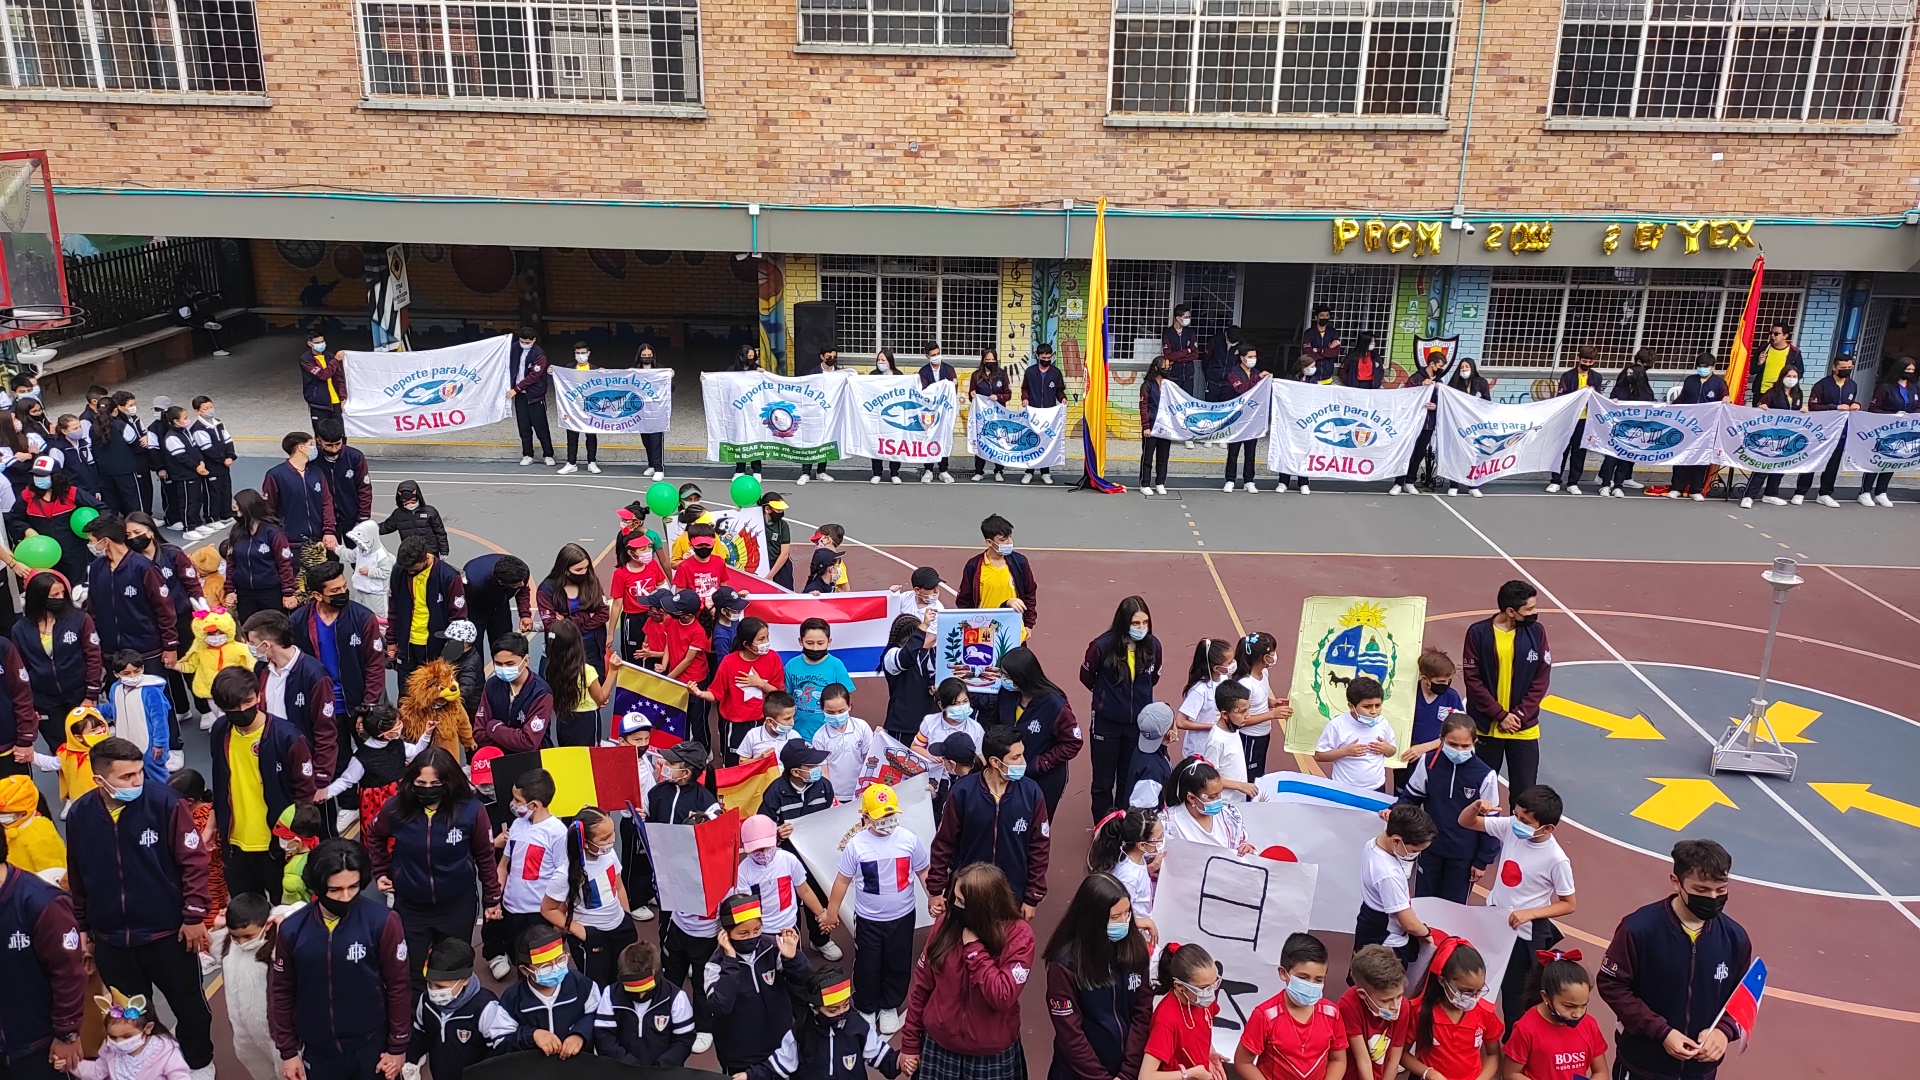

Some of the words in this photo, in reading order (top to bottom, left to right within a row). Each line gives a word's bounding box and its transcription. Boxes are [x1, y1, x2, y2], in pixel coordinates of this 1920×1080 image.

[384, 370, 428, 397] Deporte
[432, 367, 456, 379] para
[564, 378, 602, 402] Deporte
[605, 377, 628, 387] para
[632, 374, 641, 387] la
[642, 378, 660, 401] Paz
[583, 395, 644, 412] ISAILO
[733, 380, 774, 410] Deporte
[778, 383, 802, 393] para
[804, 385, 814, 398] la
[814, 392, 831, 412] Paz
[863, 388, 906, 412] Deporte
[909, 388, 930, 403] para
[940, 394, 953, 411] Paz
[394, 410, 466, 431] ISAILO
[589, 414, 642, 431] Tolerancia
[1030, 413, 1040, 426] la
[1040, 421, 1056, 439] Paz
[1296, 403, 1340, 429] Deporte
[1344, 405, 1368, 418] para
[1370, 410, 1381, 423] la
[1380, 418, 1398, 438] Paz
[1458, 421, 1498, 438] Deporte
[1500, 421, 1526, 432] para
[1595, 408, 1640, 424] Deporte
[1645, 408, 1672, 419] para
[1676, 410, 1686, 424] la
[1686, 418, 1703, 436] Paz
[1726, 414, 1773, 437] Deporte
[1775, 415, 1802, 426] para
[1803, 416, 1813, 430] la
[1811, 424, 1828, 444] Paz
[1856, 420, 1908, 441] Deporte
[1610, 422, 1684, 446] ISAILO
[1743, 432, 1809, 452] ISAILO
[878, 438, 941, 457] ISAILO
[1608, 438, 1673, 462] Superación
[1733, 444, 1808, 470] Perseverancia
[1307, 455, 1374, 475] ISAILO
[1466, 455, 1516, 480] ISAILO
[1555, 1051, 1585, 1064] BOSS
